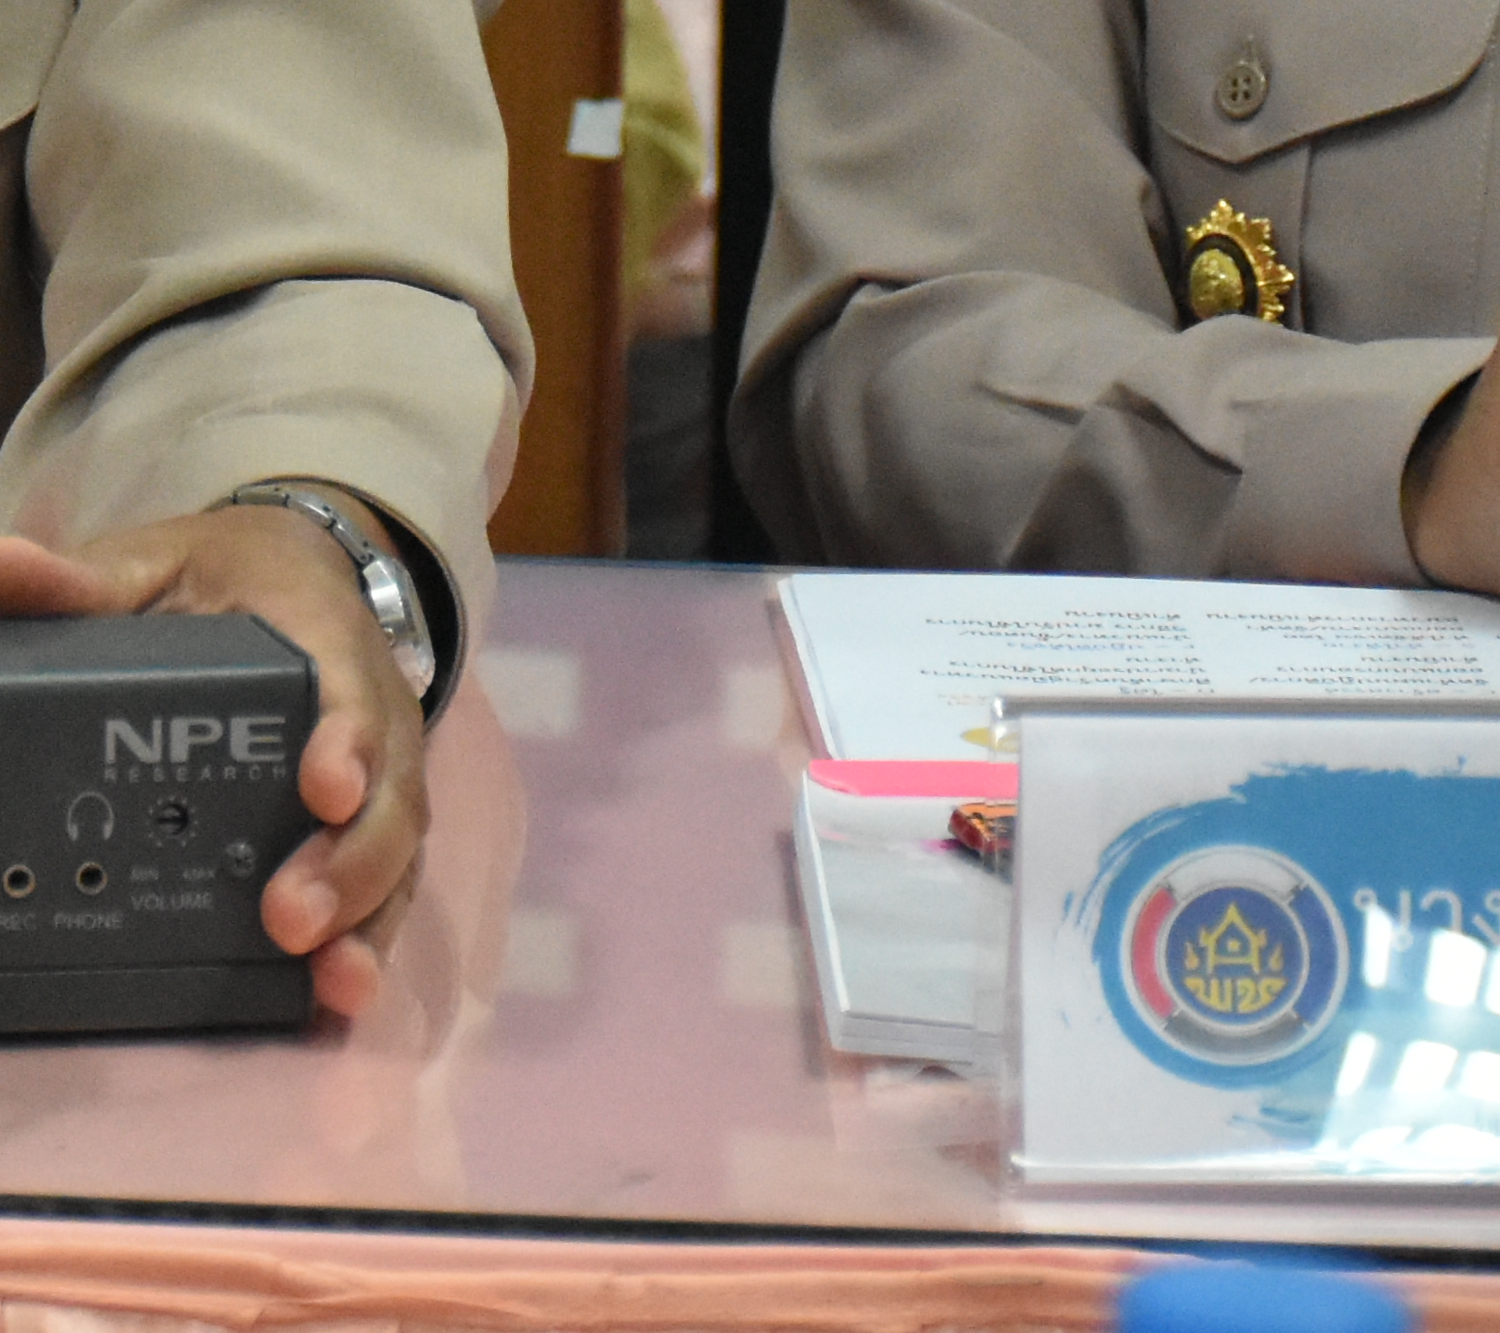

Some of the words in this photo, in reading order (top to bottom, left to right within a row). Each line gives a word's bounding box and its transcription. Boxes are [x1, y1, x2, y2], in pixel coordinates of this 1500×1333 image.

[103, 715, 287, 765] NPE
[103, 763, 288, 783] RESEARCH
[129, 891, 214, 911] VOLUME
[52, 910, 124, 930] PHONE
